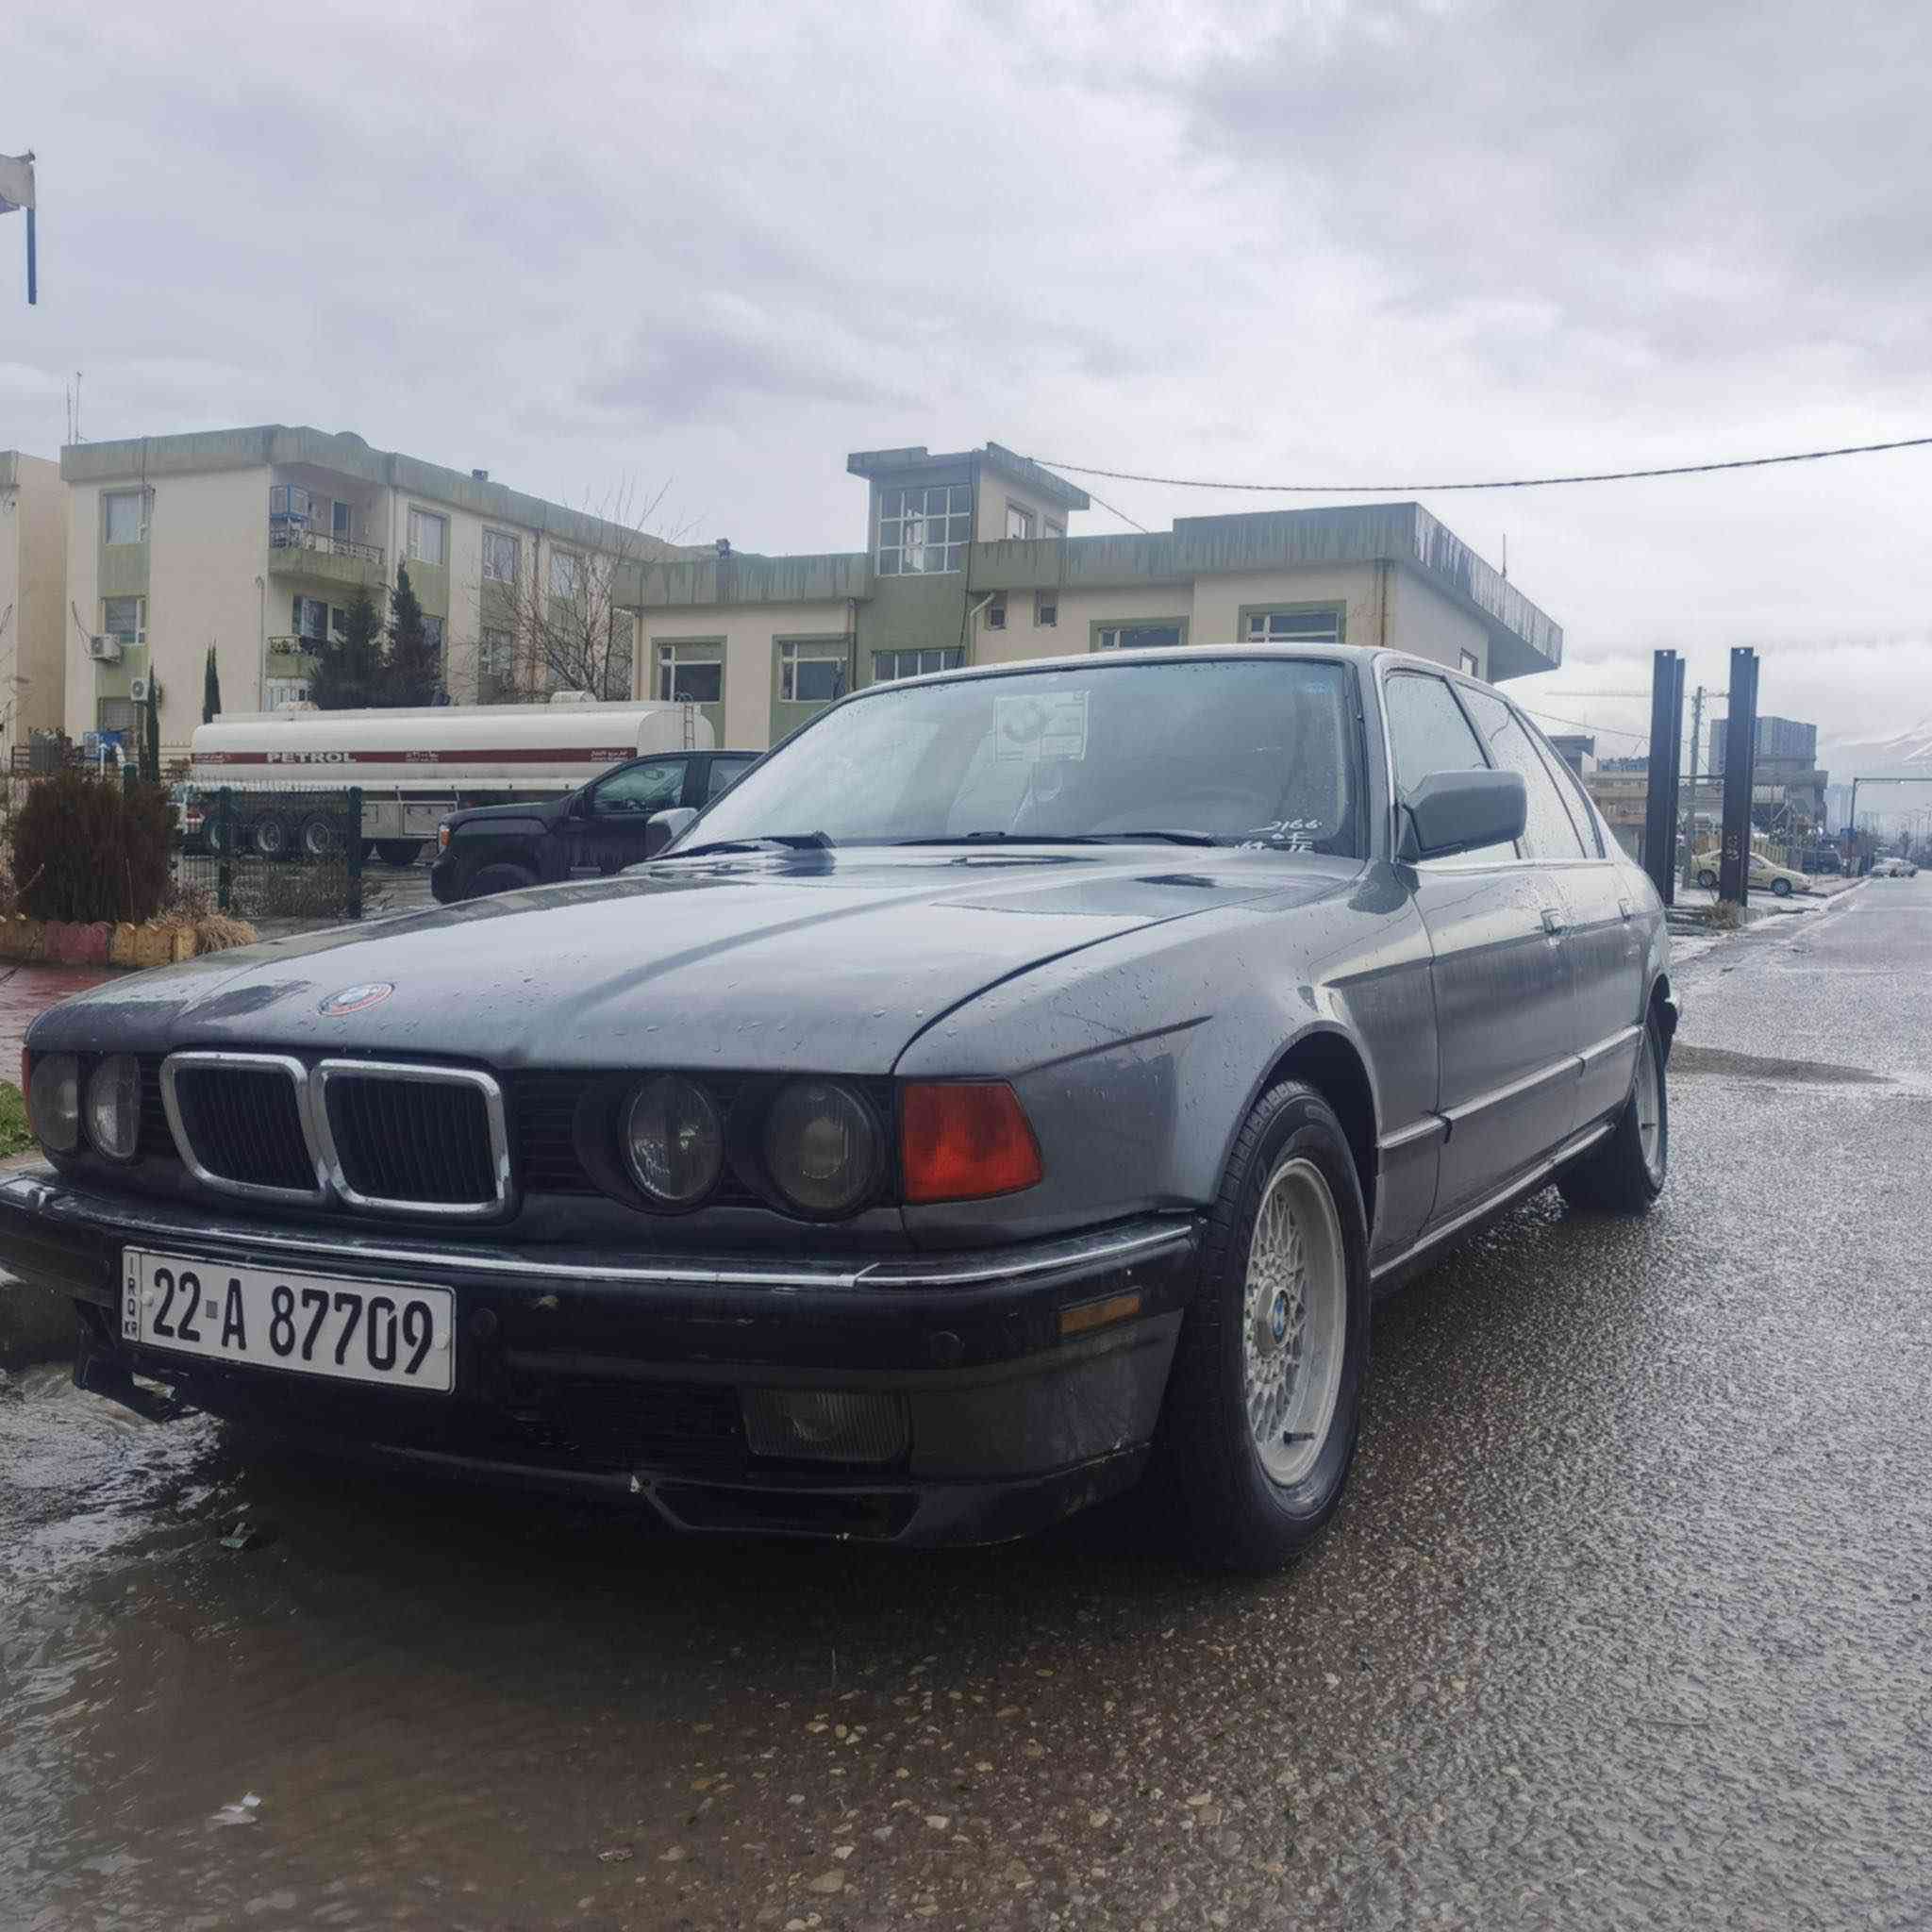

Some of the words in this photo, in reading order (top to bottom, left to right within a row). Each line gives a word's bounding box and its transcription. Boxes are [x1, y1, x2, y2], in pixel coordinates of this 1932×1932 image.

[267, 752, 356, 763] PETROL
[153, 1267, 201, 1341] 22
[221, 1277, 247, 1351] A
[269, 1285, 434, 1374] 87709
